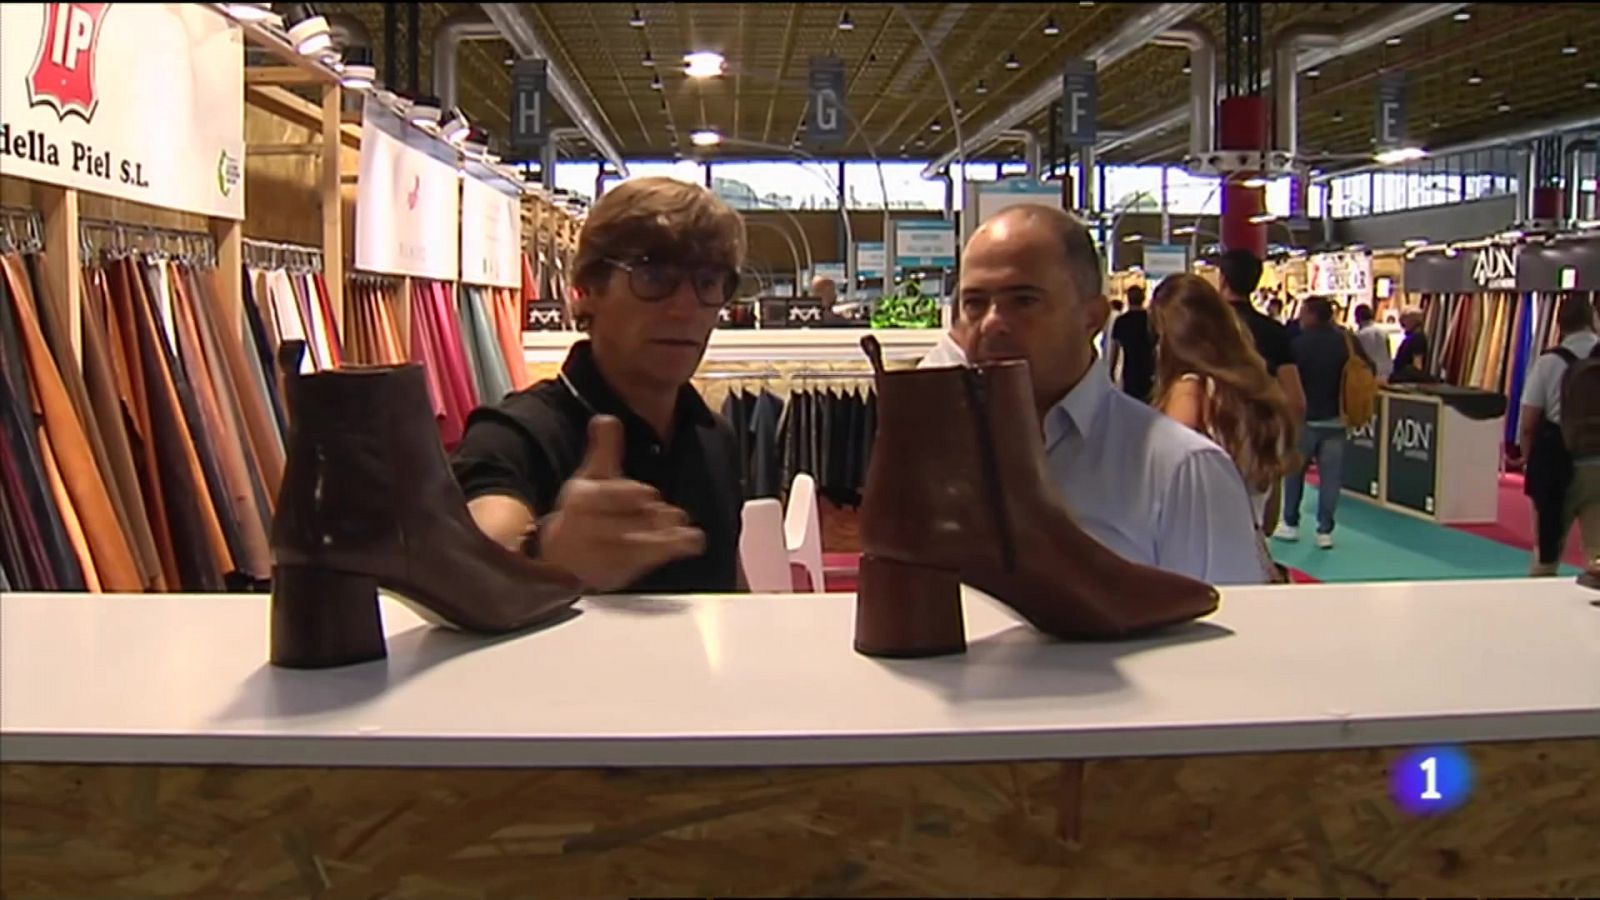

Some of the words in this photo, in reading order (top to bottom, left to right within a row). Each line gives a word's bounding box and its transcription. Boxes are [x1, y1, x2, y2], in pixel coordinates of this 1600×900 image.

[51, 3, 95, 71] IP
[519, 91, 540, 134] H
[816, 89, 838, 130] G
[1070, 92, 1088, 134] F
[1383, 102, 1400, 143] E
[71, 140, 111, 180] Piel
[119, 159, 150, 188] S.L.
[1472, 246, 1517, 282] ADN
[1392, 418, 1432, 452] ADN
